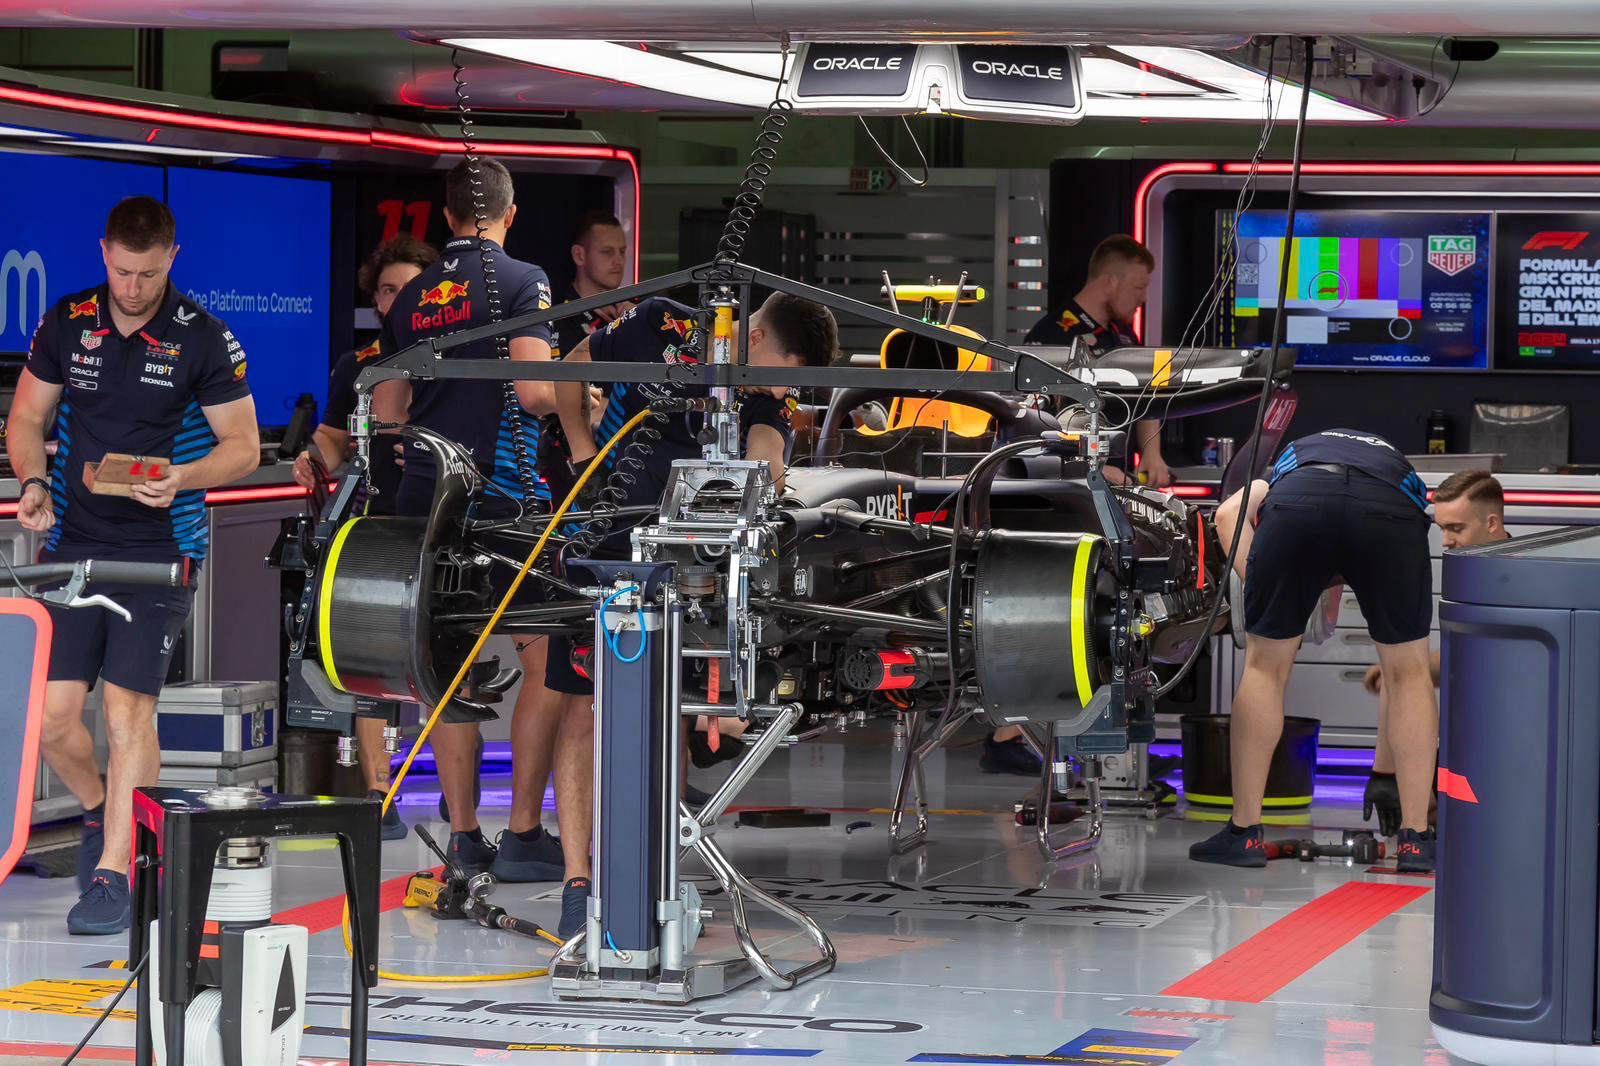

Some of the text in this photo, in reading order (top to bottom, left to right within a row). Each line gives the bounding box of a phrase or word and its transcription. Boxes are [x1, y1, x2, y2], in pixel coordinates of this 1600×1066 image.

[813, 57, 902, 71] ORACLE
[972, 60, 1063, 80] ORACLE
[446, 239, 472, 249] HONDA
[1432, 239, 1472, 251] TAG
[1431, 253, 1473, 273] HEUER
[1519, 272, 1559, 285] MSC
[1519, 286, 1570, 298] GRAN
[209, 288, 255, 312] Platform
[257, 292, 268, 312] to
[270, 292, 312, 314] Connect
[1519, 299, 1552, 312] DEL
[412, 300, 472, 332] Red Bull
[1518, 312, 1530, 326] E
[71, 353, 94, 366] Mobil
[70, 366, 100, 378] ORACLE
[144, 363, 174, 376] BYBIT
[140, 376, 174, 388] HONDA
